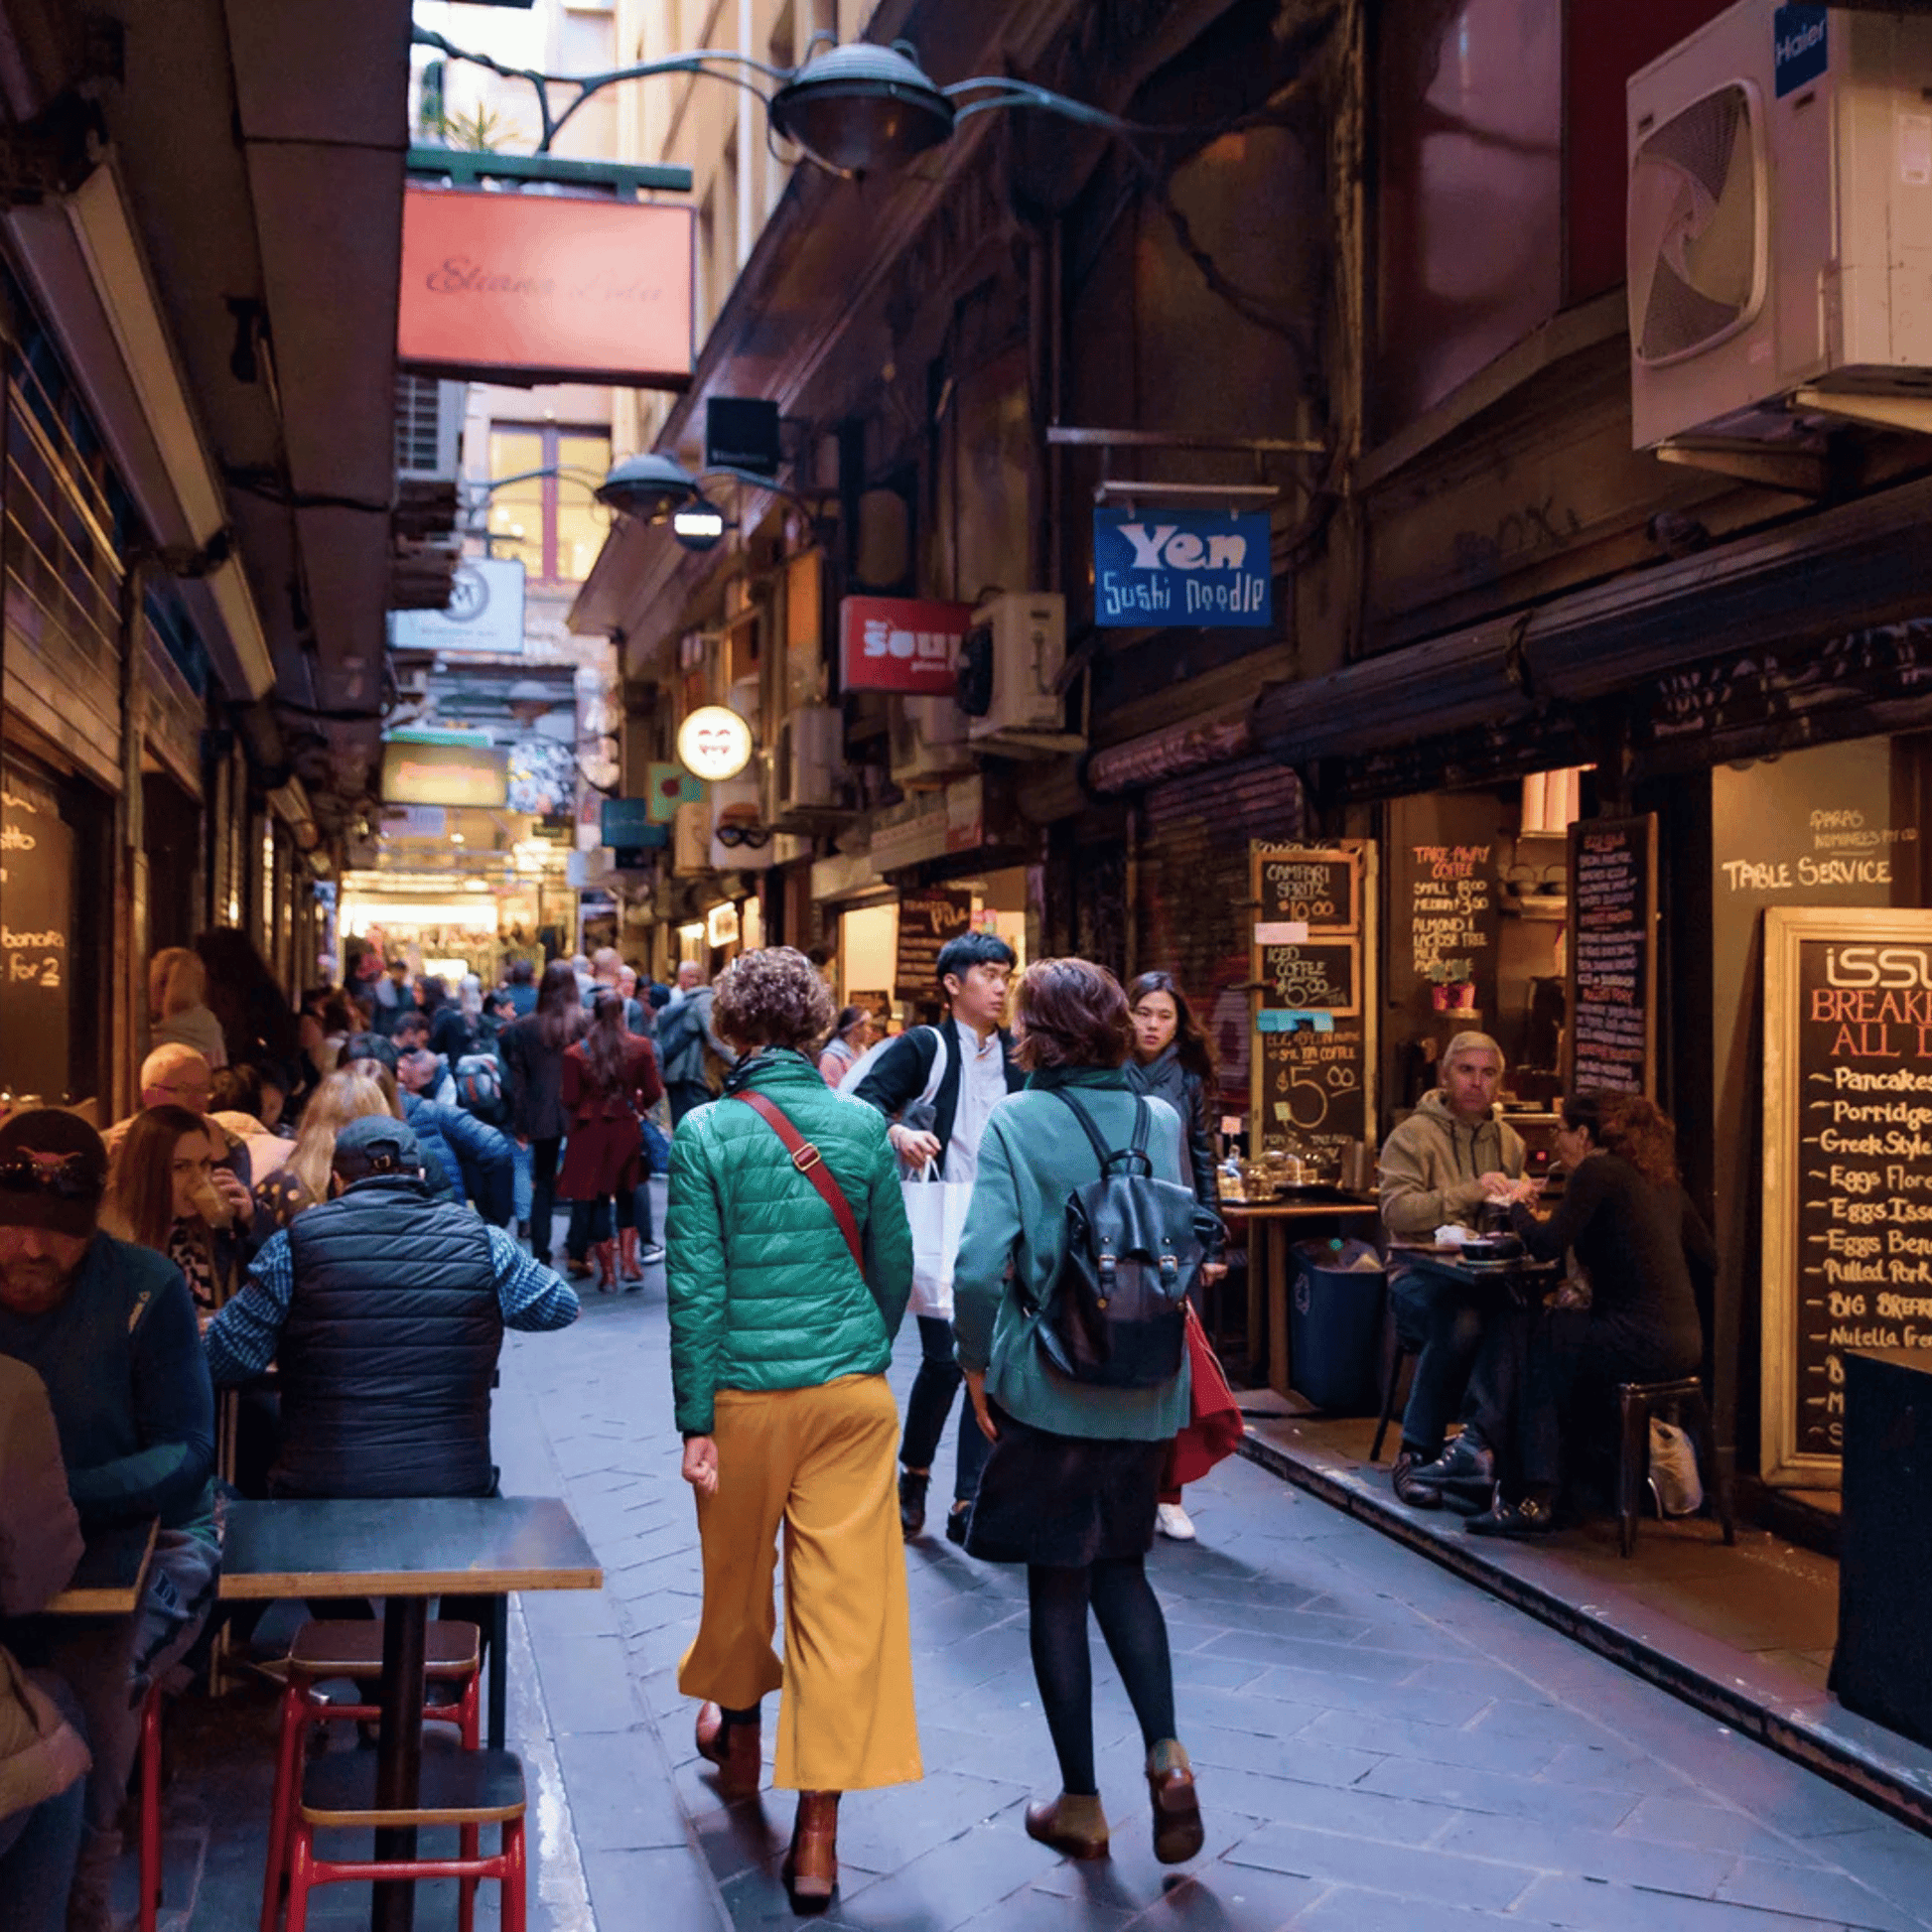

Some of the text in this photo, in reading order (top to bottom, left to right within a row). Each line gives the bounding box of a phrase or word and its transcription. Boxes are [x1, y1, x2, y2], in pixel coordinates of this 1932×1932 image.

[1775, 18, 1825, 68] Haier
[1116, 523, 1247, 570] Yen
[1103, 571, 1172, 615] Sushi
[1722, 856, 1892, 891] TABLE SERVICE
[1830, 1023, 1901, 1056] ALL
[1833, 1100, 1932, 1131] Porridge
[1820, 1128, 1932, 1161] Greek Style
[1830, 1165, 1881, 1193] Eggs
[1828, 1196, 1886, 1224] Eggs
[1827, 1228, 1881, 1258] Eggs
[1823, 1258, 1932, 1284] Pulled Pork
[1828, 1292, 1866, 1317] BIG
[1829, 1324, 1899, 1347] Nutella
